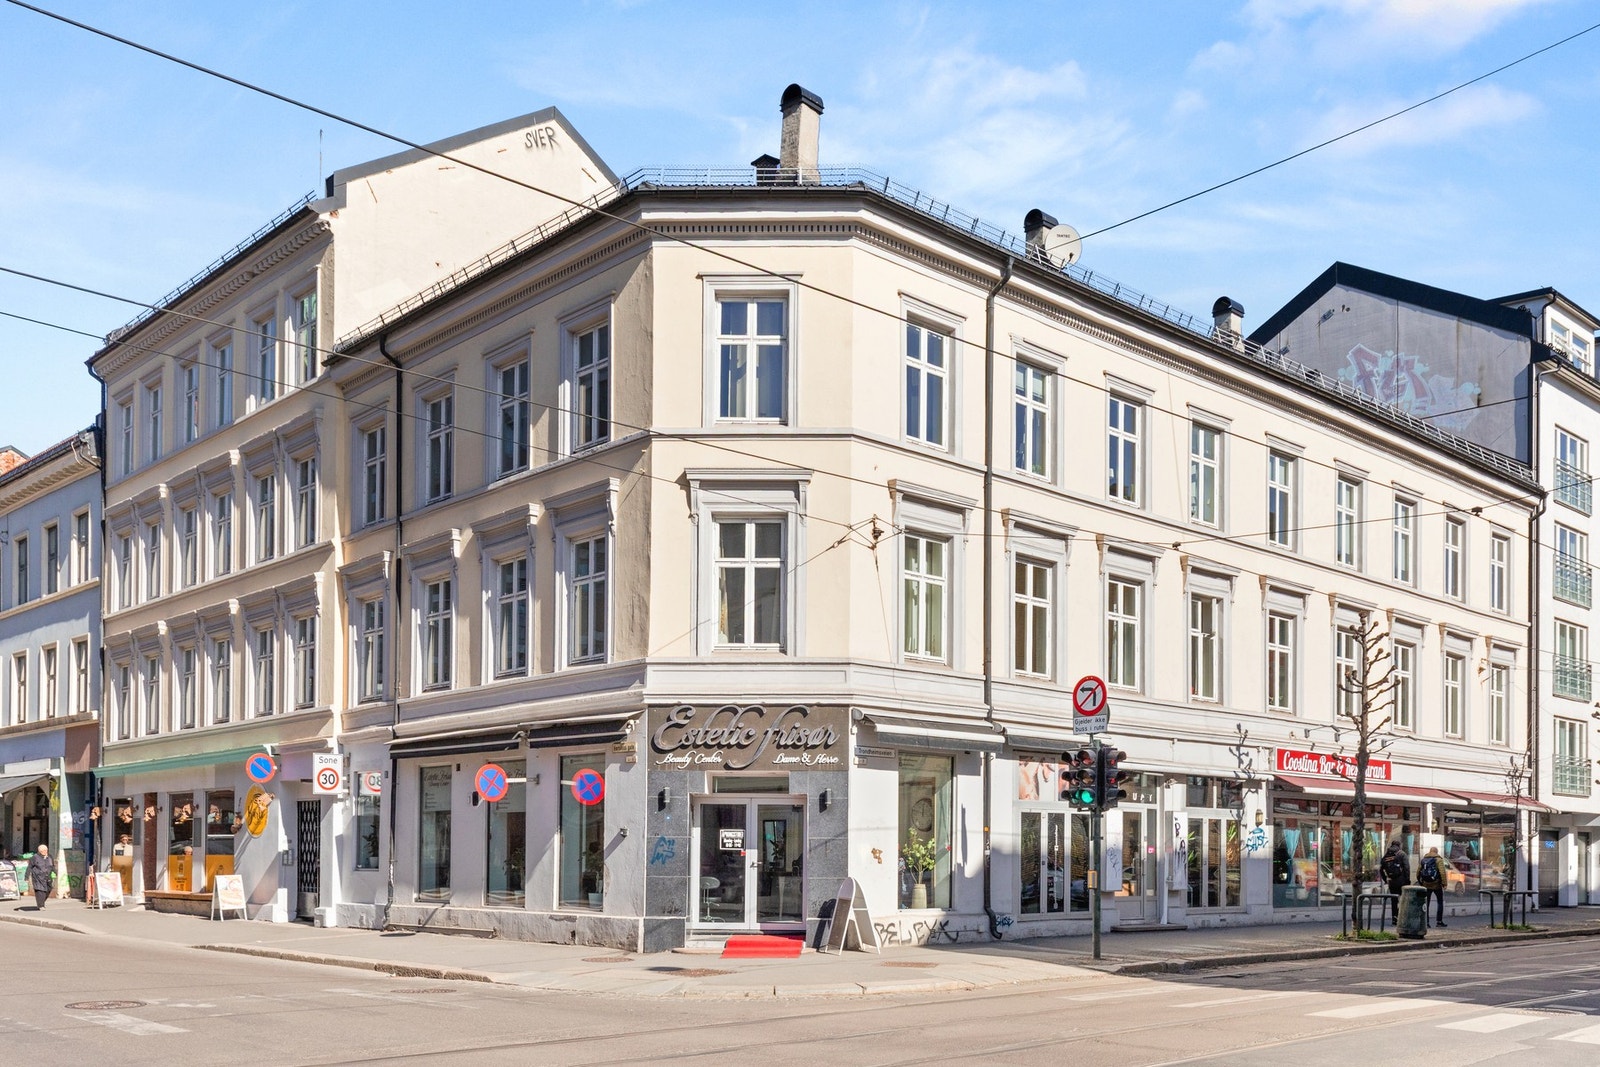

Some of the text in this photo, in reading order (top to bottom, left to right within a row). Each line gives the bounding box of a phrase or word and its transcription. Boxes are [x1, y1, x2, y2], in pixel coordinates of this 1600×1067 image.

[524, 126, 559, 151] SVER
[653, 705, 766, 751] Estetic
[1075, 718, 1092, 726] Gjelder
[318, 756, 338, 764] Sone
[656, 751, 724, 768] Beauty Center
[772, 753, 800, 764] Dame
[801, 752, 810, 763] &
[1283, 751, 1318, 772] Coostina
[1320, 755, 1335, 774] Bar
[321, 773, 336, 785] 30
